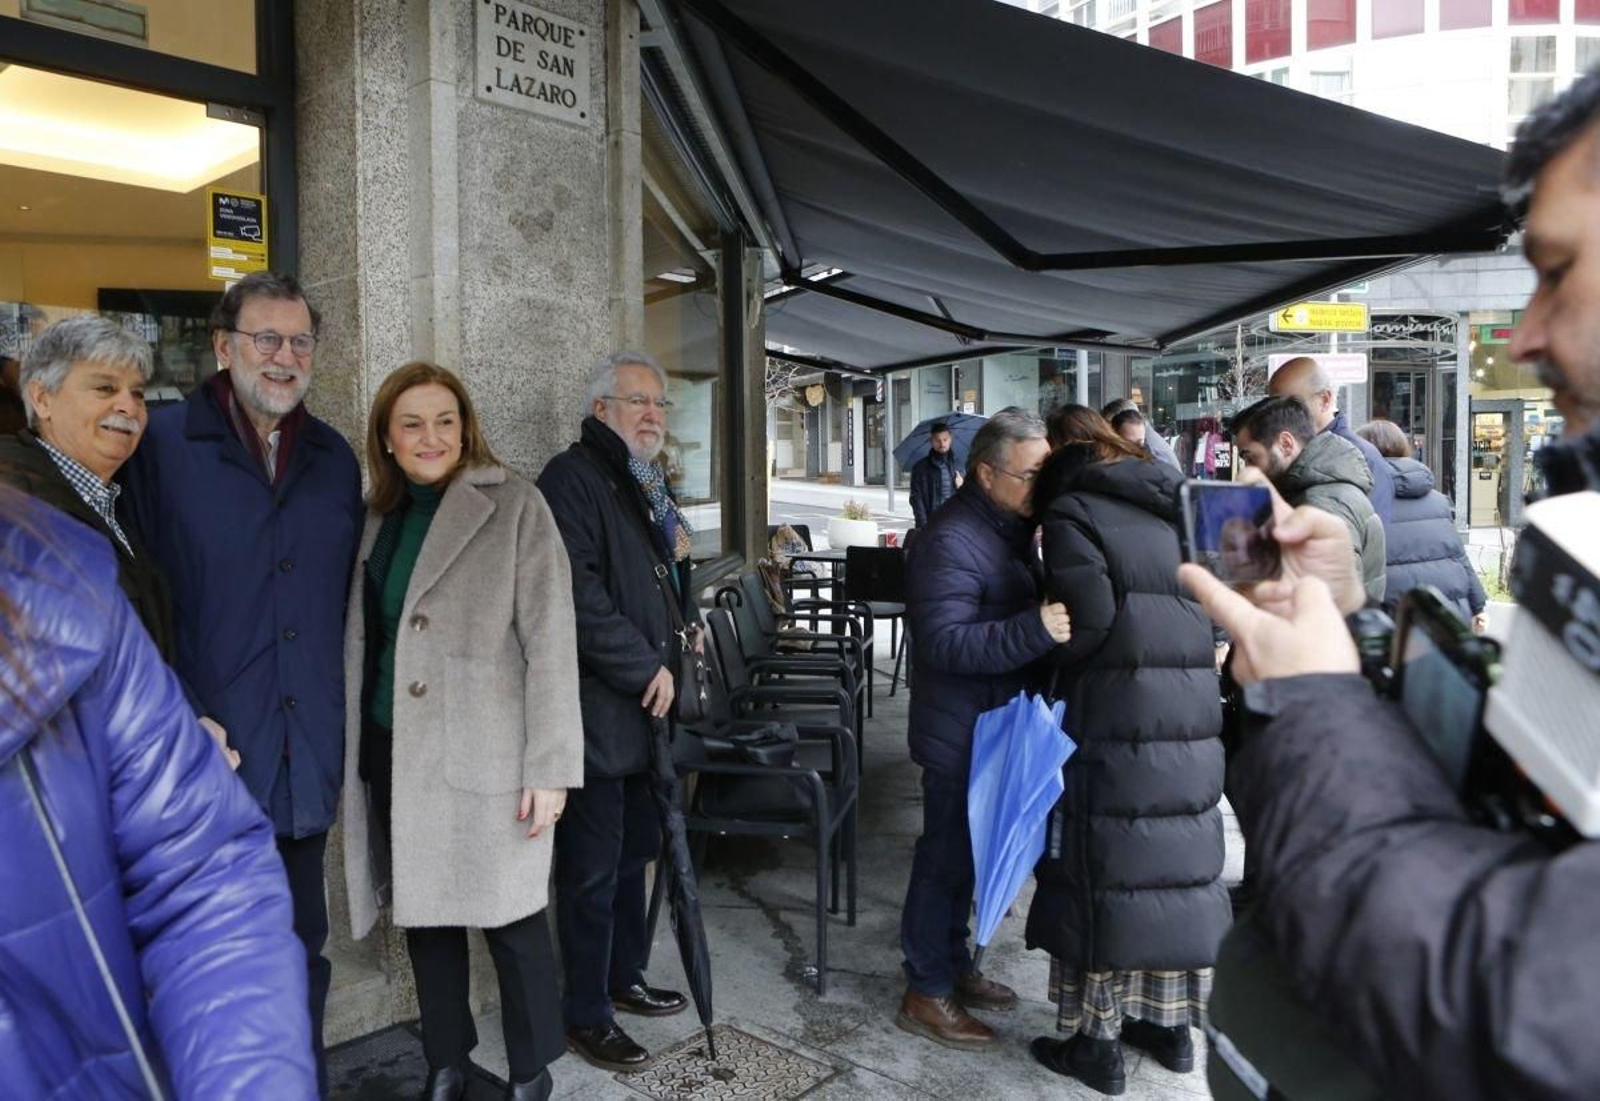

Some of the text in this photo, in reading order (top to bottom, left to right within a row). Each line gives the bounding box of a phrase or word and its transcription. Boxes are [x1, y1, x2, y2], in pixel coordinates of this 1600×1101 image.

[494, 3, 575, 49] PARQUE
[496, 35, 575, 79] DE SAN
[495, 67, 577, 108] LAZARO
